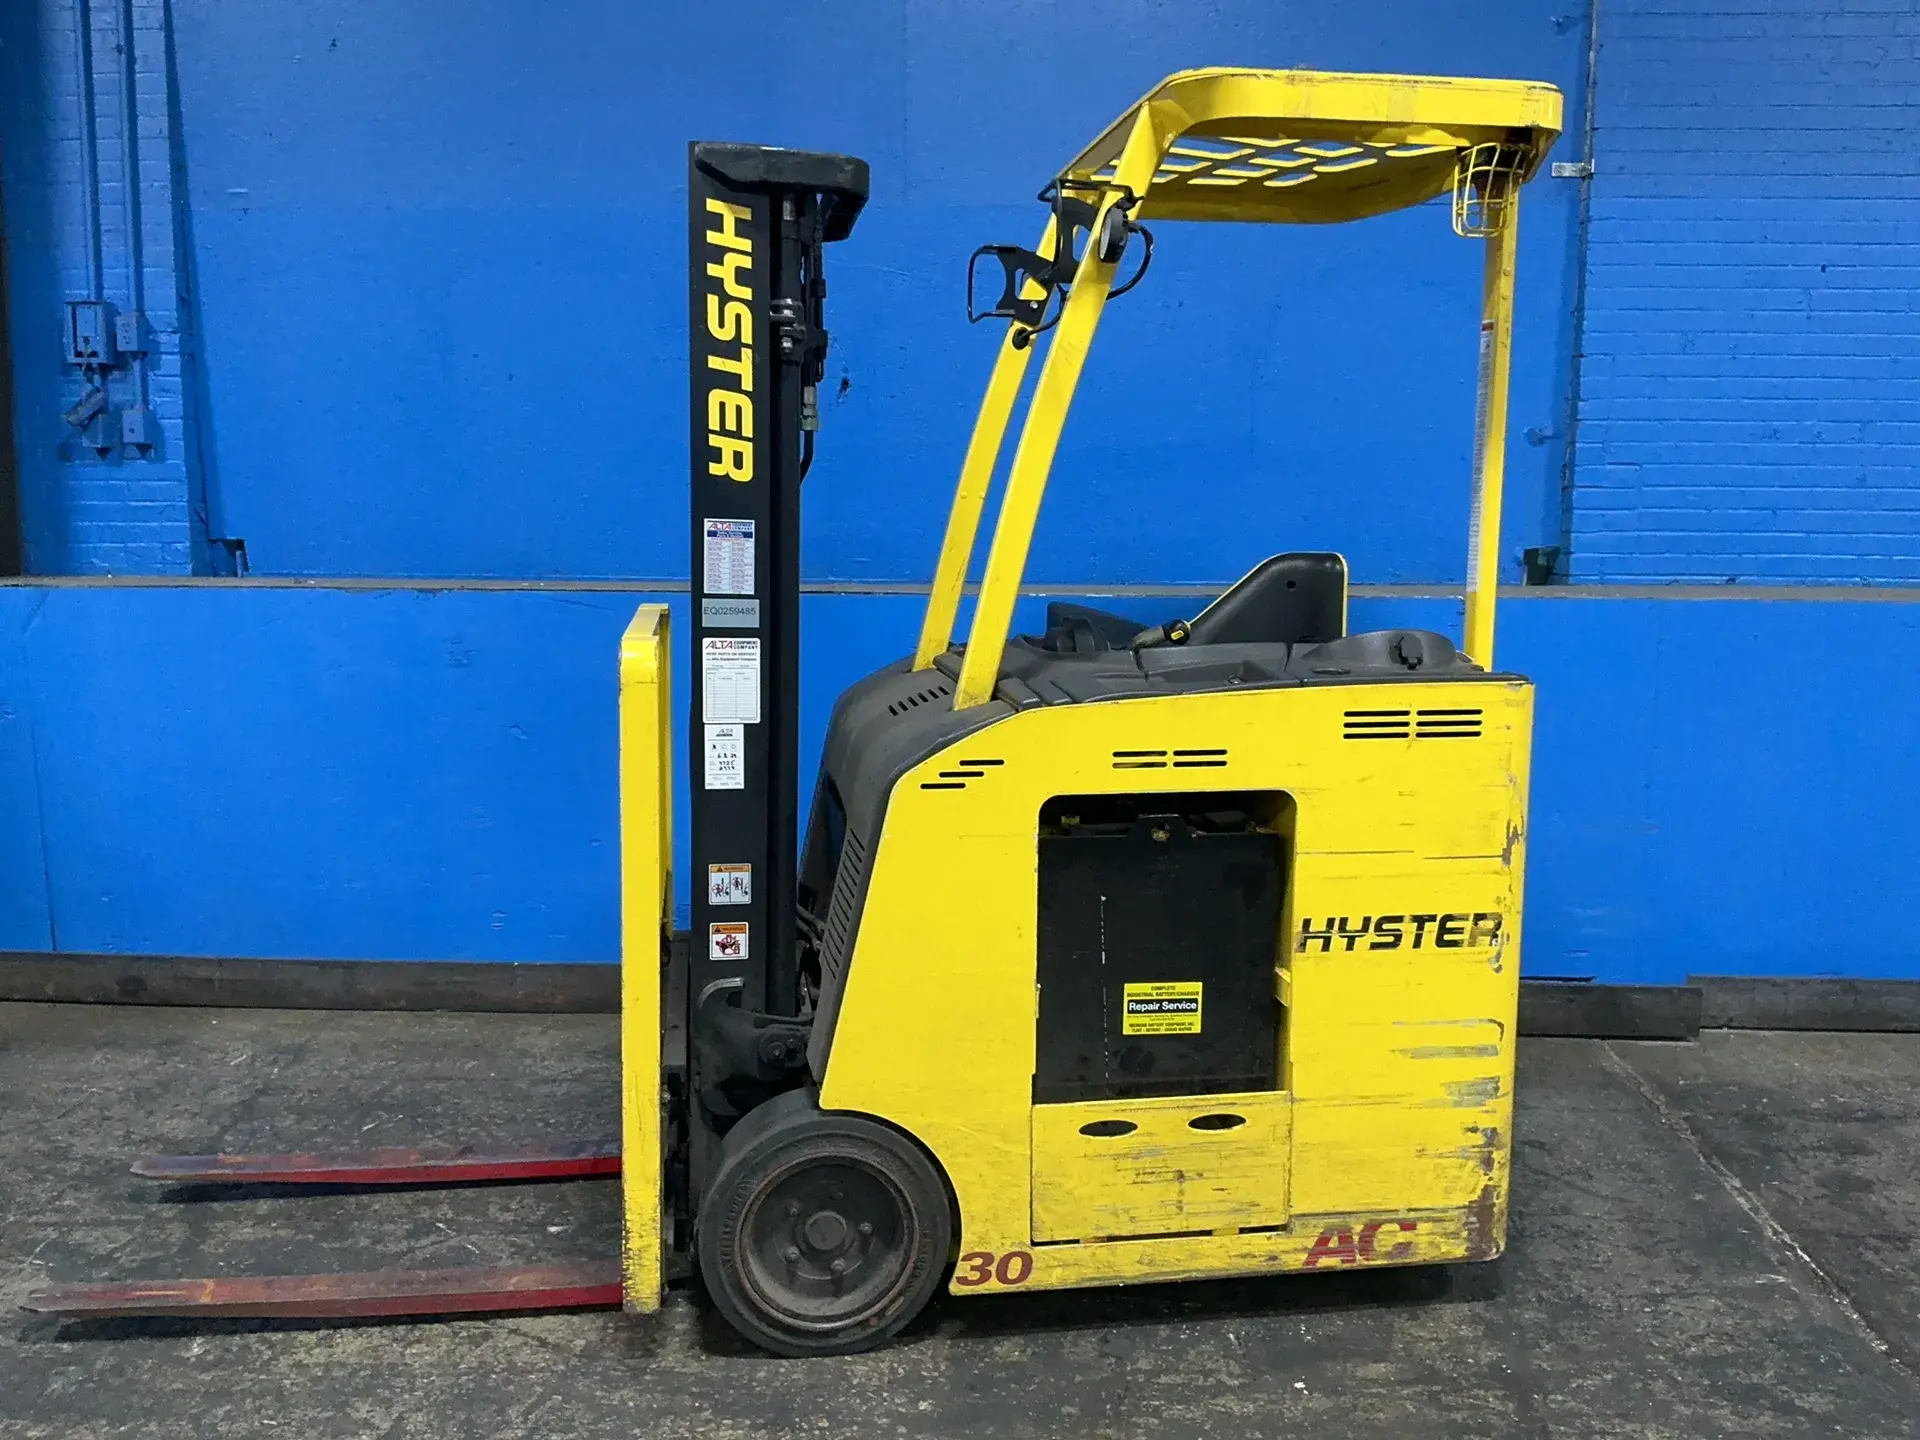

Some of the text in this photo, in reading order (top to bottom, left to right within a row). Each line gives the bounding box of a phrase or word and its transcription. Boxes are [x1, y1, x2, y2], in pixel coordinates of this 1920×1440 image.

[706, 198, 753, 482] HYSTER
[708, 522, 732, 530] ALTA
[704, 606, 756, 615] EQ0259485
[705, 640, 733, 649] ALTA
[1296, 912, 1503, 953] HYSTER
[1129, 1001, 1197, 1012] Repair Service
[1303, 1220, 1417, 1266] AC
[955, 1251, 1033, 1286] 30
